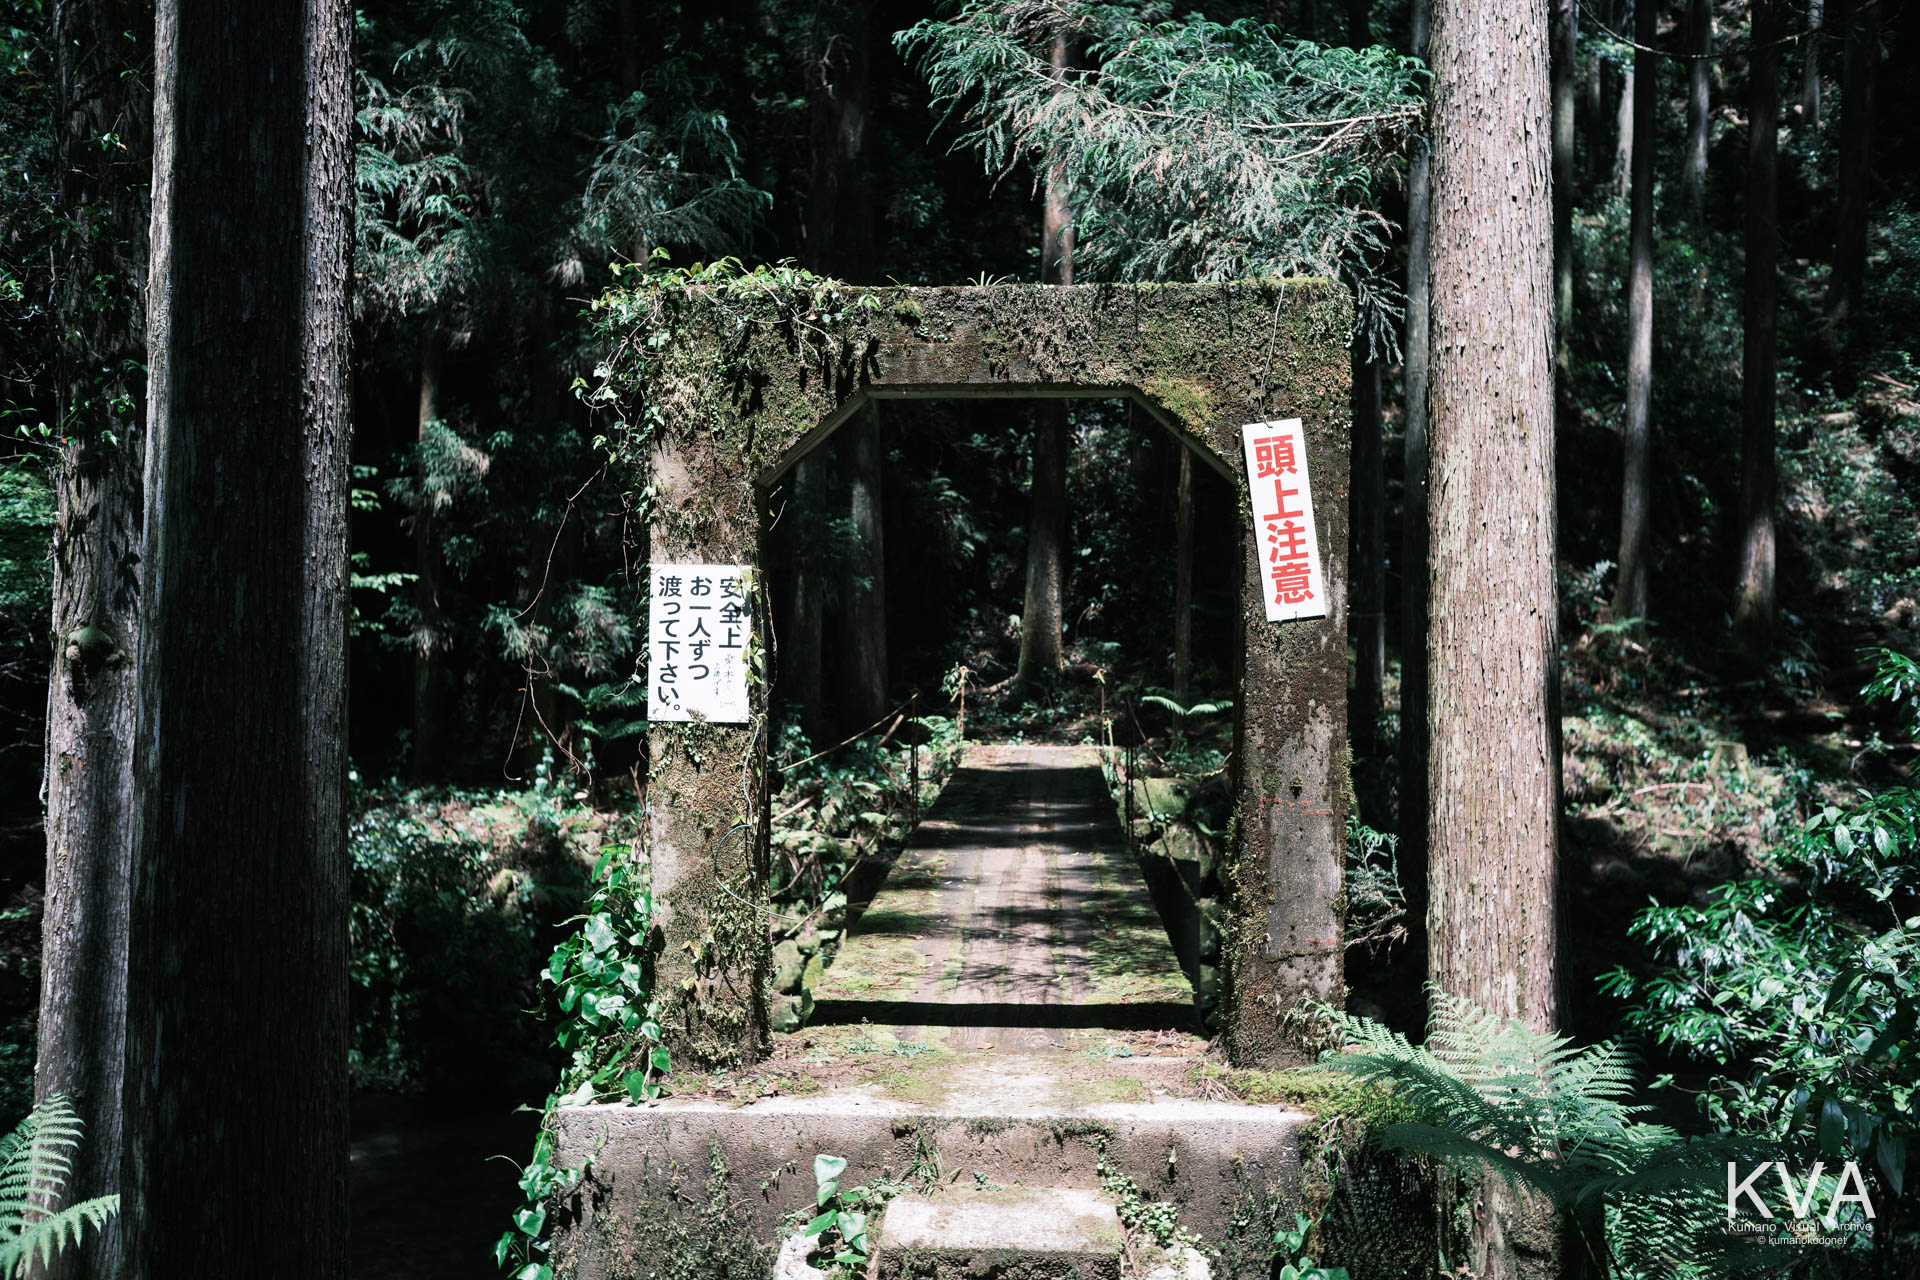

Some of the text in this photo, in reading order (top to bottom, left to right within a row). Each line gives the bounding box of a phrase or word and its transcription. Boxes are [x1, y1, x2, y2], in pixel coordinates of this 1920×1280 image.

[1253, 434, 1315, 605] 頭上注意
[658, 576, 683, 711] 渡って下さい。
[688, 576, 713, 680] お一人ずつ
[718, 576, 743, 648] 安全上
